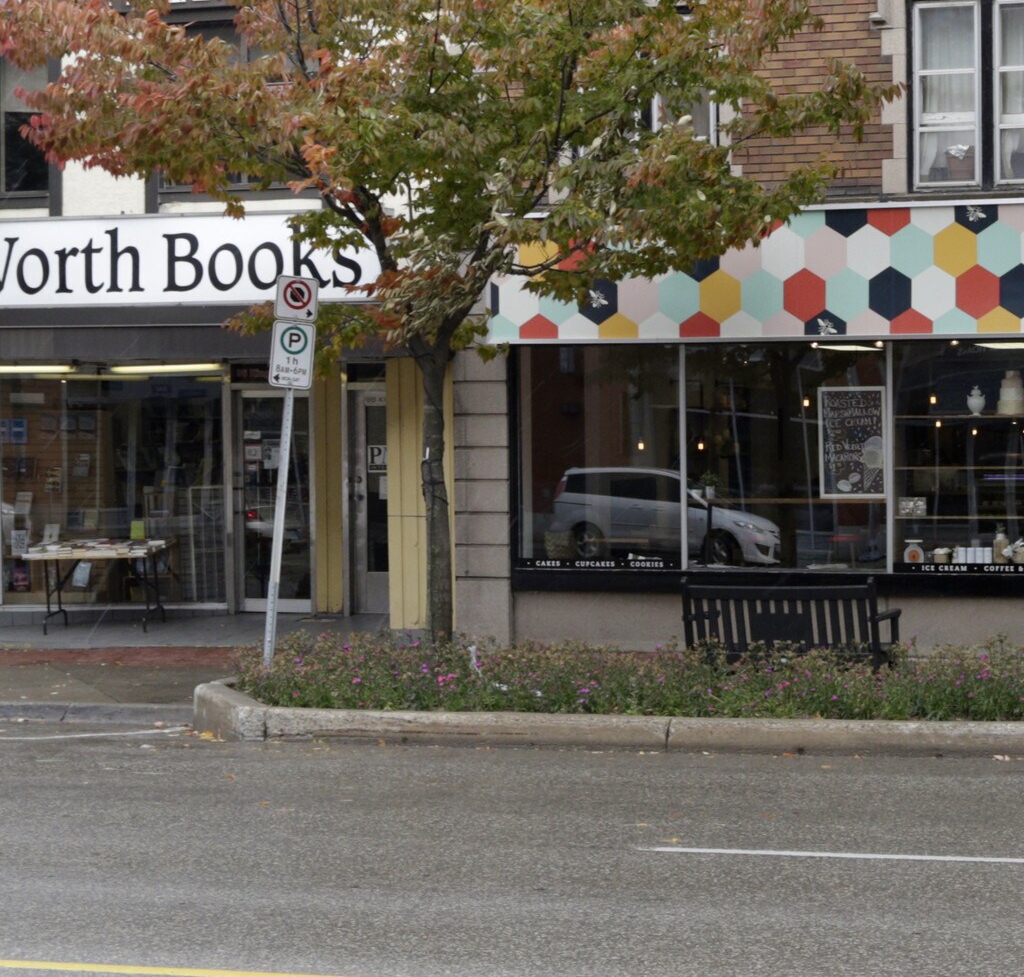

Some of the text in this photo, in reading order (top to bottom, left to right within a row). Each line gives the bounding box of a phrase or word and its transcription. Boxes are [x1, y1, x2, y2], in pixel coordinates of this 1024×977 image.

[162, 221, 363, 292] Books
[288, 332, 302, 348] P
[575, 560, 615, 568] CUPCAKES
